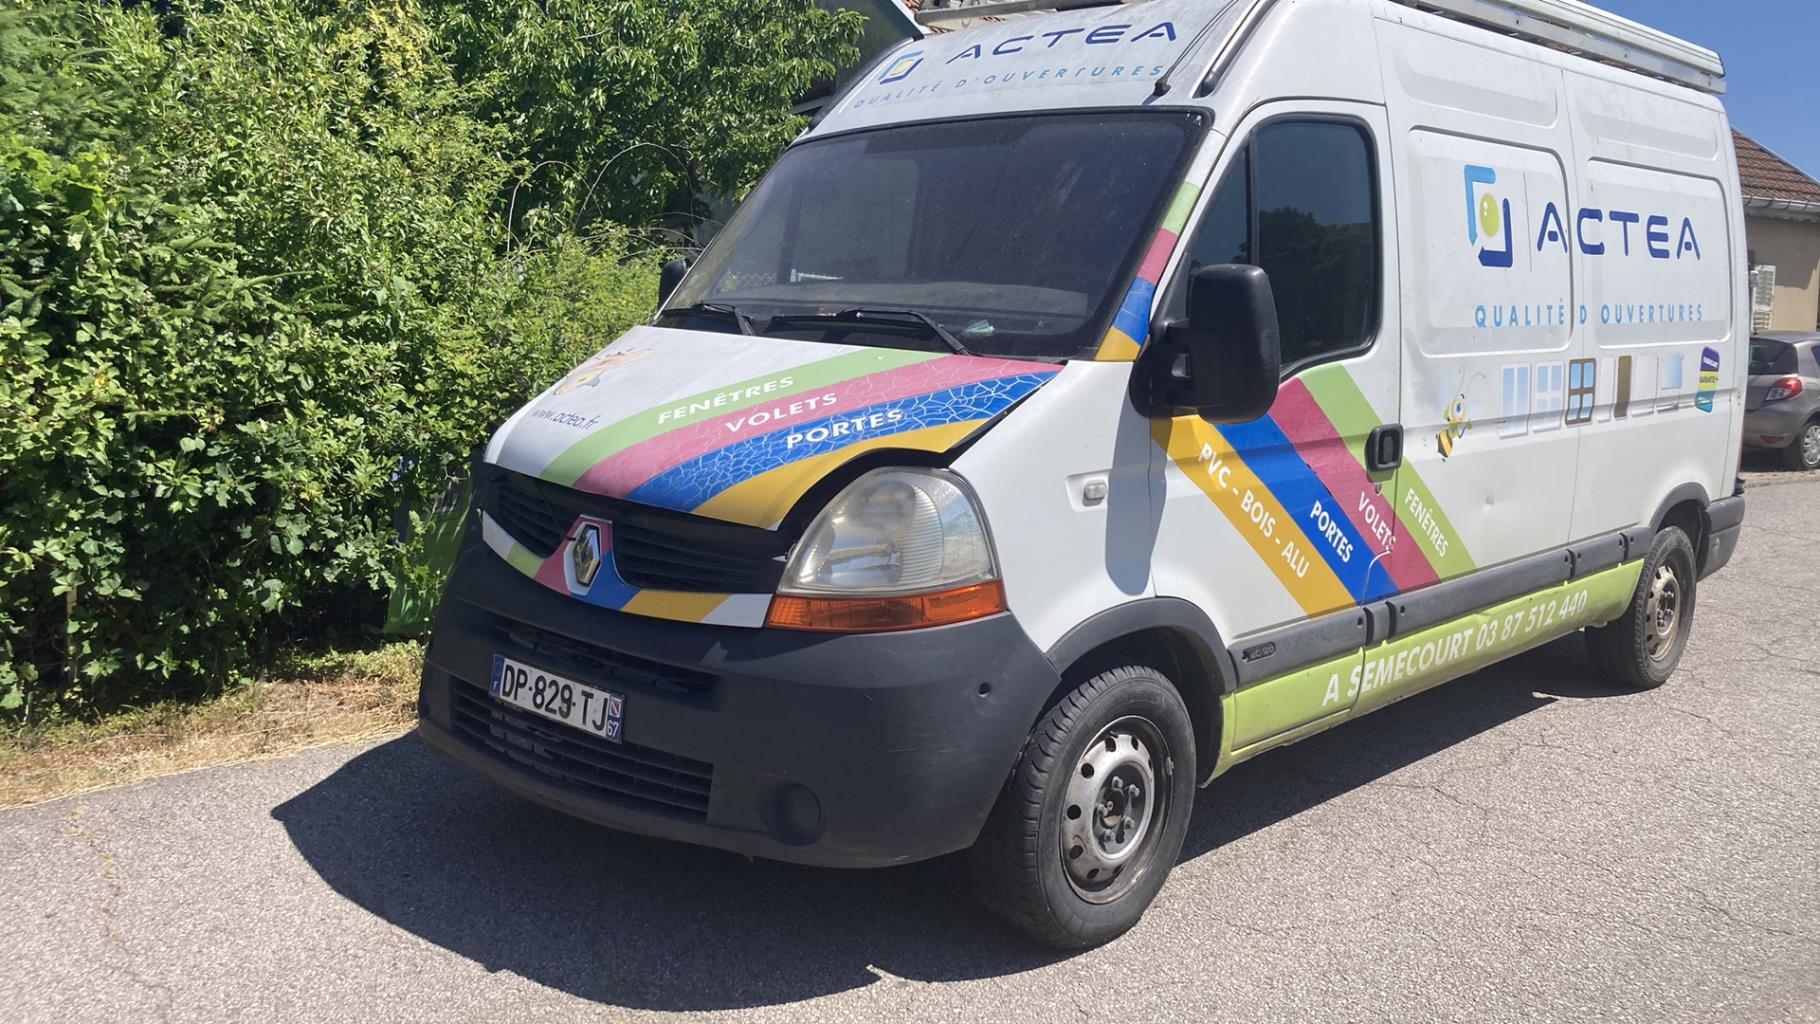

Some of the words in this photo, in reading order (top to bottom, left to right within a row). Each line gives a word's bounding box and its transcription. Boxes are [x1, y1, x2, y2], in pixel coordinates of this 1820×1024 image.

[946, 21, 1178, 65] ACTEA
[854, 80, 943, 109] QUALITÉ
[955, 65, 1164, 88] D'OUVERTURES
[1537, 201, 1701, 260] ACTEA
[1475, 297, 1565, 328] QUALITÉ
[658, 376, 795, 425] FENÊTRES
[725, 392, 838, 433] VOLETS
[786, 408, 903, 450] PORTES
[1198, 442, 1231, 489] PVC
[1240, 489, 1276, 538] BOIS
[1281, 541, 1310, 578] ALU
[1309, 500, 1354, 563] PORTES
[1358, 491, 1397, 551] VOLETS
[1404, 487, 1449, 558] FENÊTRES
[1321, 673, 1340, 707] A
[1346, 627, 1474, 697] SEMECOURT
[1475, 620, 1499, 650] 03
[1501, 610, 1524, 640] 87
[1525, 600, 1556, 632] 512
[1559, 589, 1588, 619] 440
[502, 664, 610, 732] DP-829-TJ
[607, 719, 619, 737] 67
